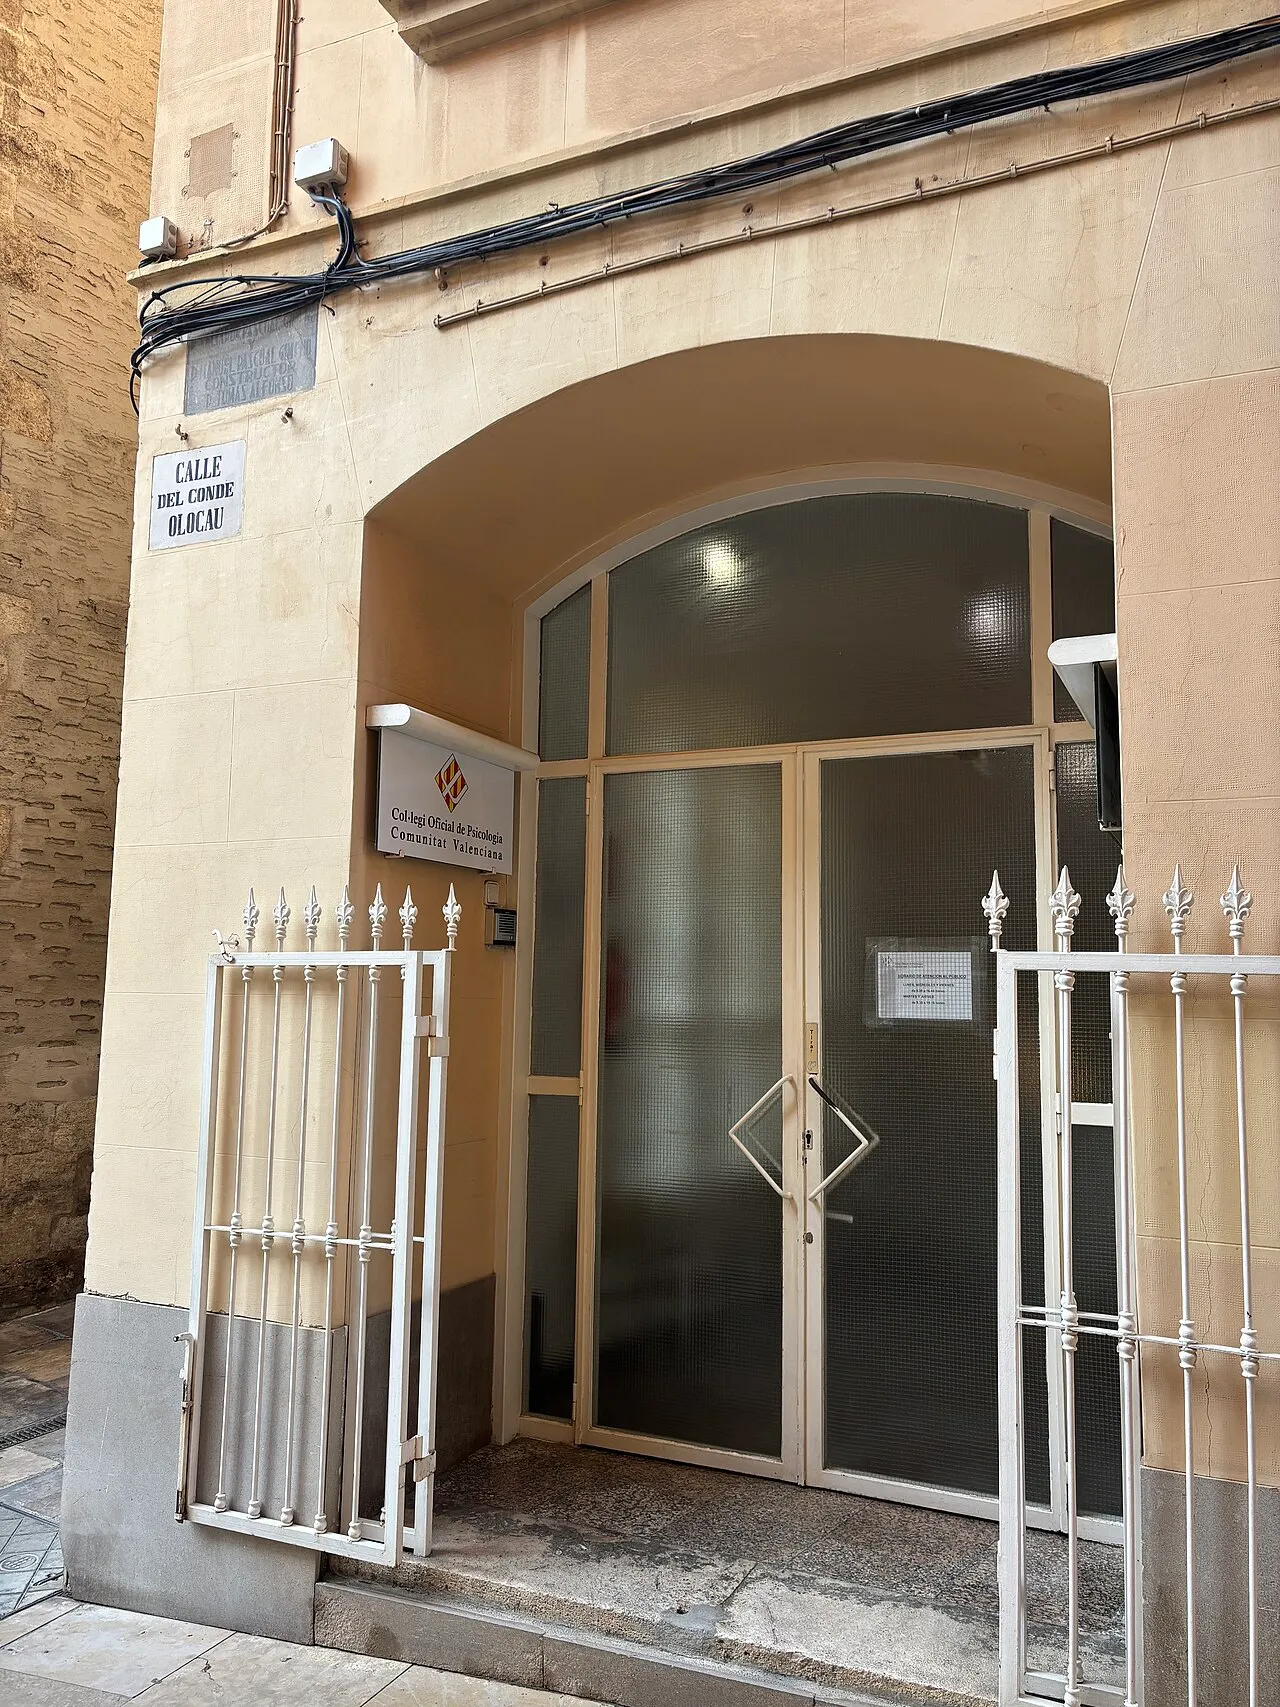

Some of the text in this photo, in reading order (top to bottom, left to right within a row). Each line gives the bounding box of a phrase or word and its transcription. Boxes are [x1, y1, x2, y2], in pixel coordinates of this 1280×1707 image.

[175, 455, 222, 484] CALLE
[157, 481, 234, 509] DEL CONDE
[168, 507, 224, 537] OLOCAU
[427, 815, 455, 833] Oficial
[456, 822, 466, 835] de
[390, 825, 503, 861] Comunitat Valenciana
